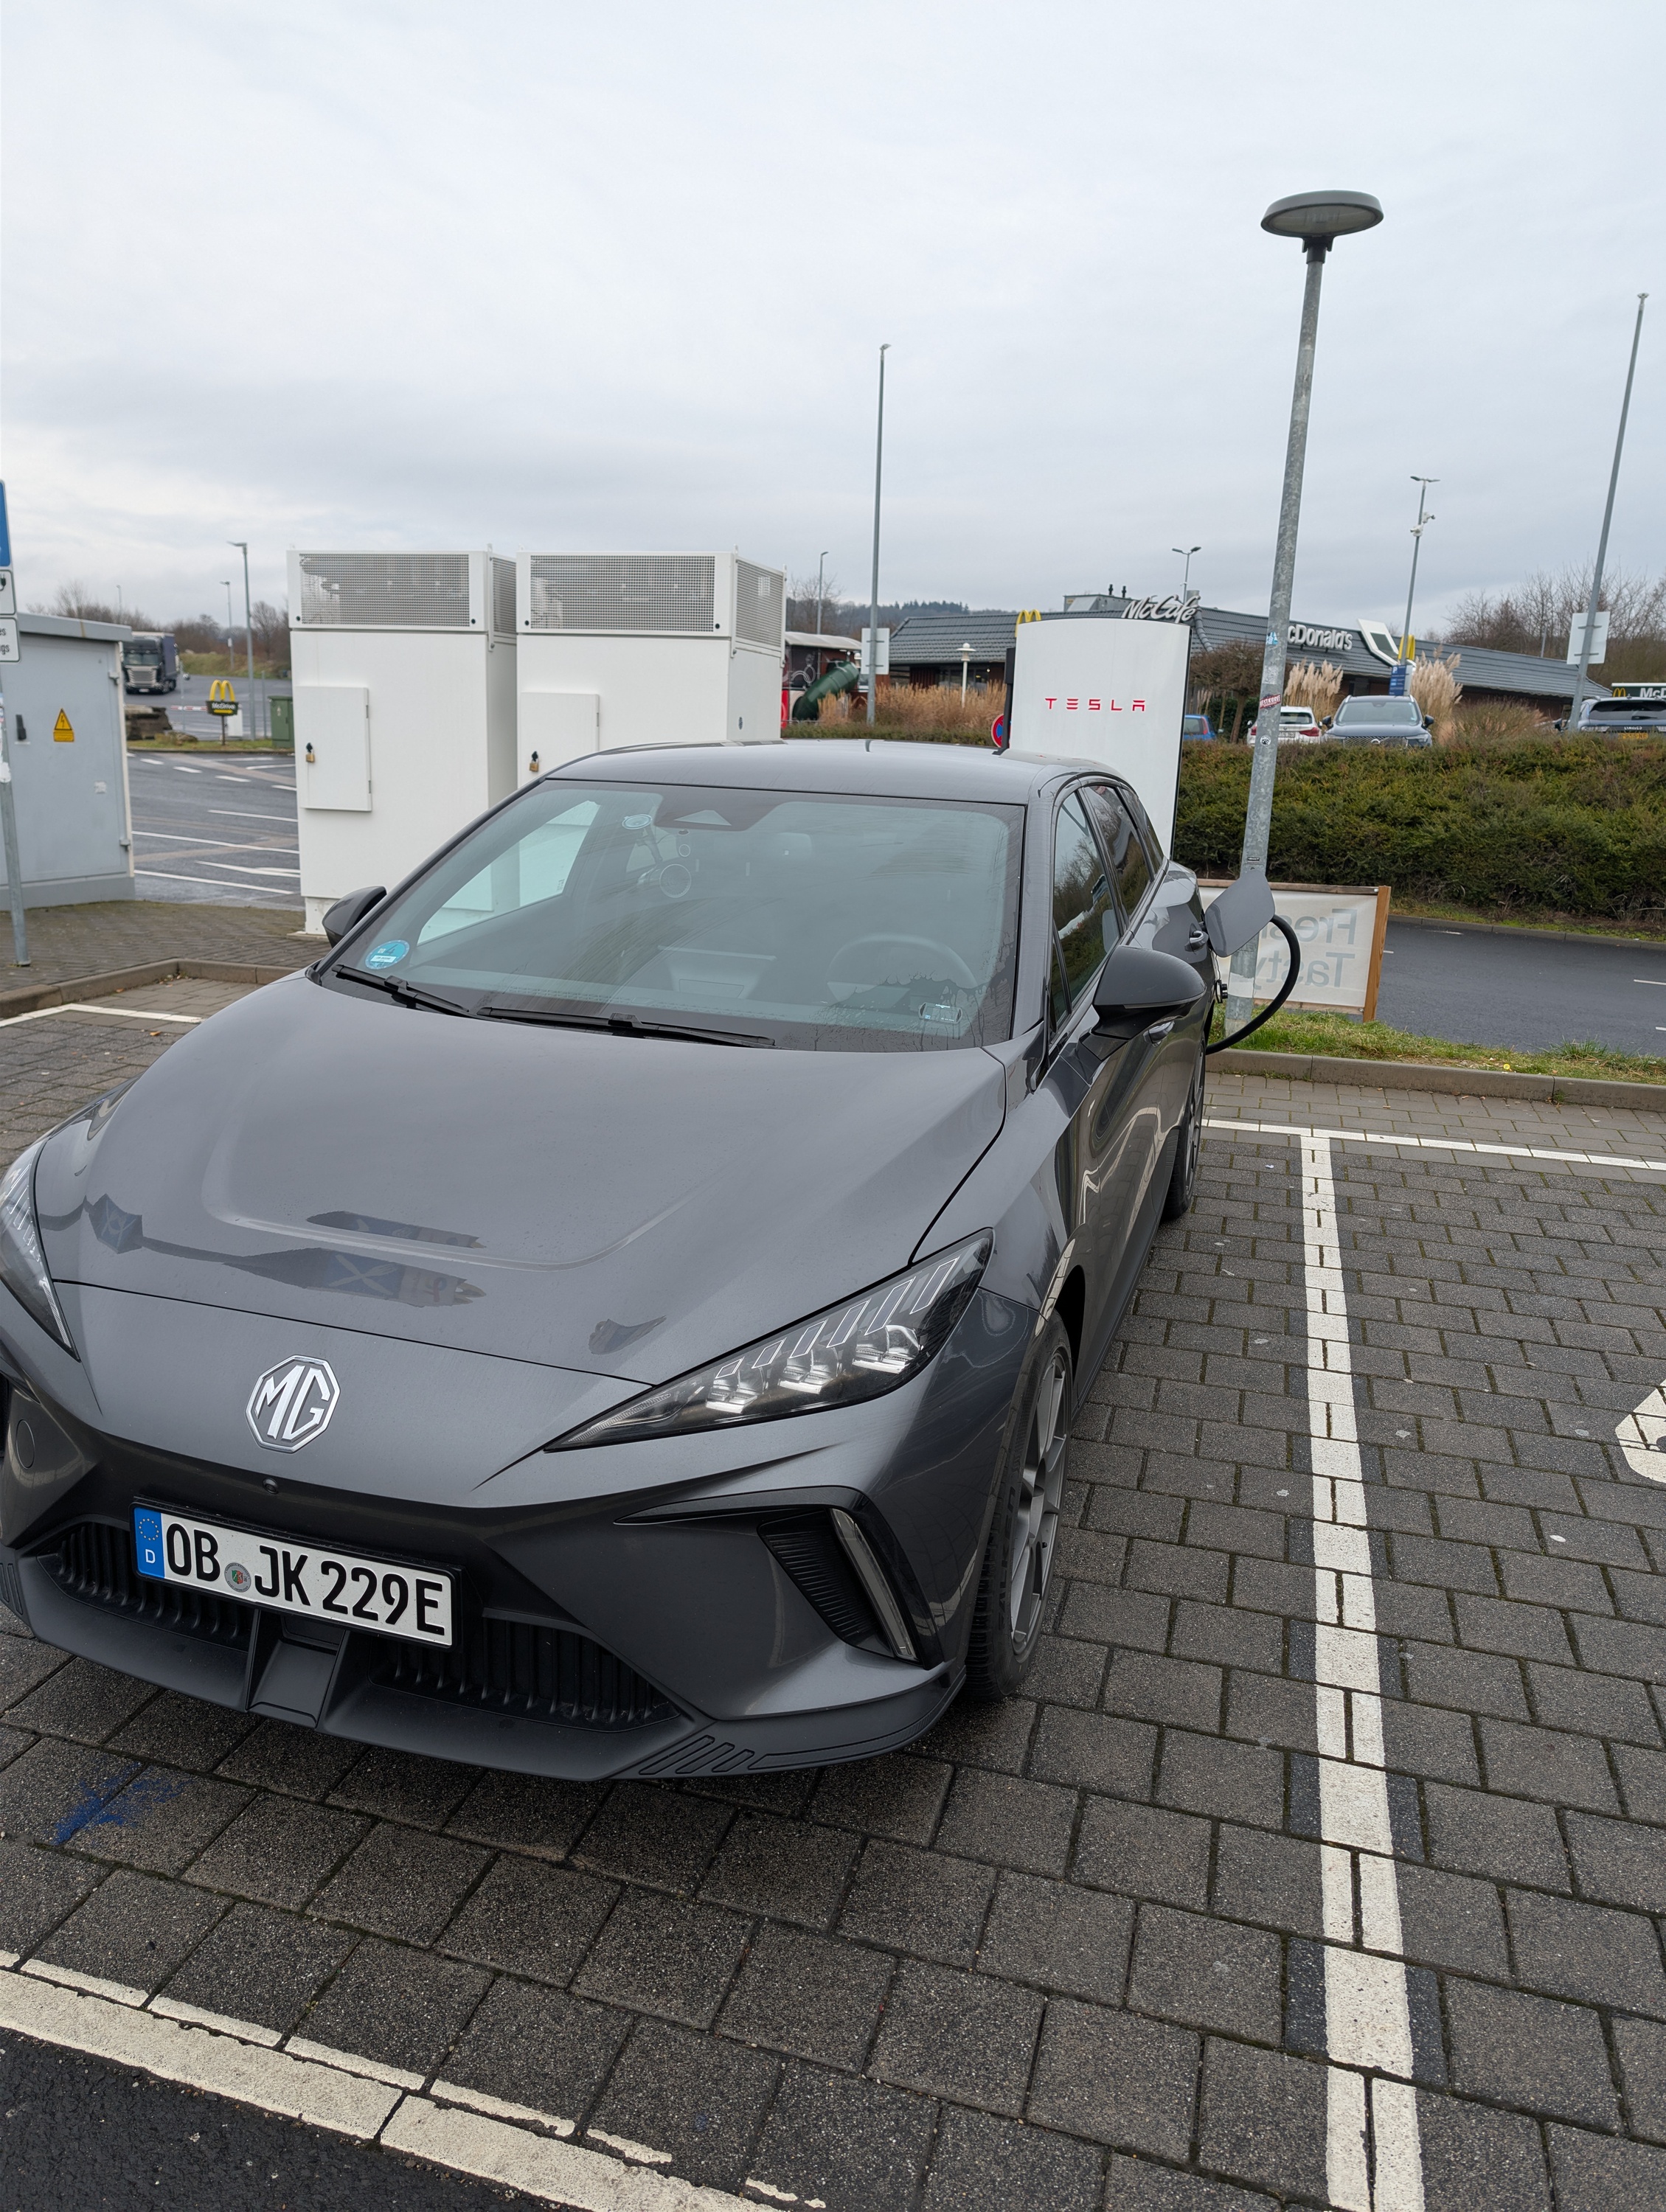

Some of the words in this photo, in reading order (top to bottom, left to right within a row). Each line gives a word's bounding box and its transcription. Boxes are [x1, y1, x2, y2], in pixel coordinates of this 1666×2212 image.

[1288, 624, 1353, 650] cDonald's
[1044, 698, 1146, 712] TESLA
[254, 1364, 332, 1442] MG
[145, 1548, 156, 1564] D
[166, 1523, 221, 1582] OB
[254, 1545, 311, 1607] JK
[320, 1559, 445, 1636] 229E
